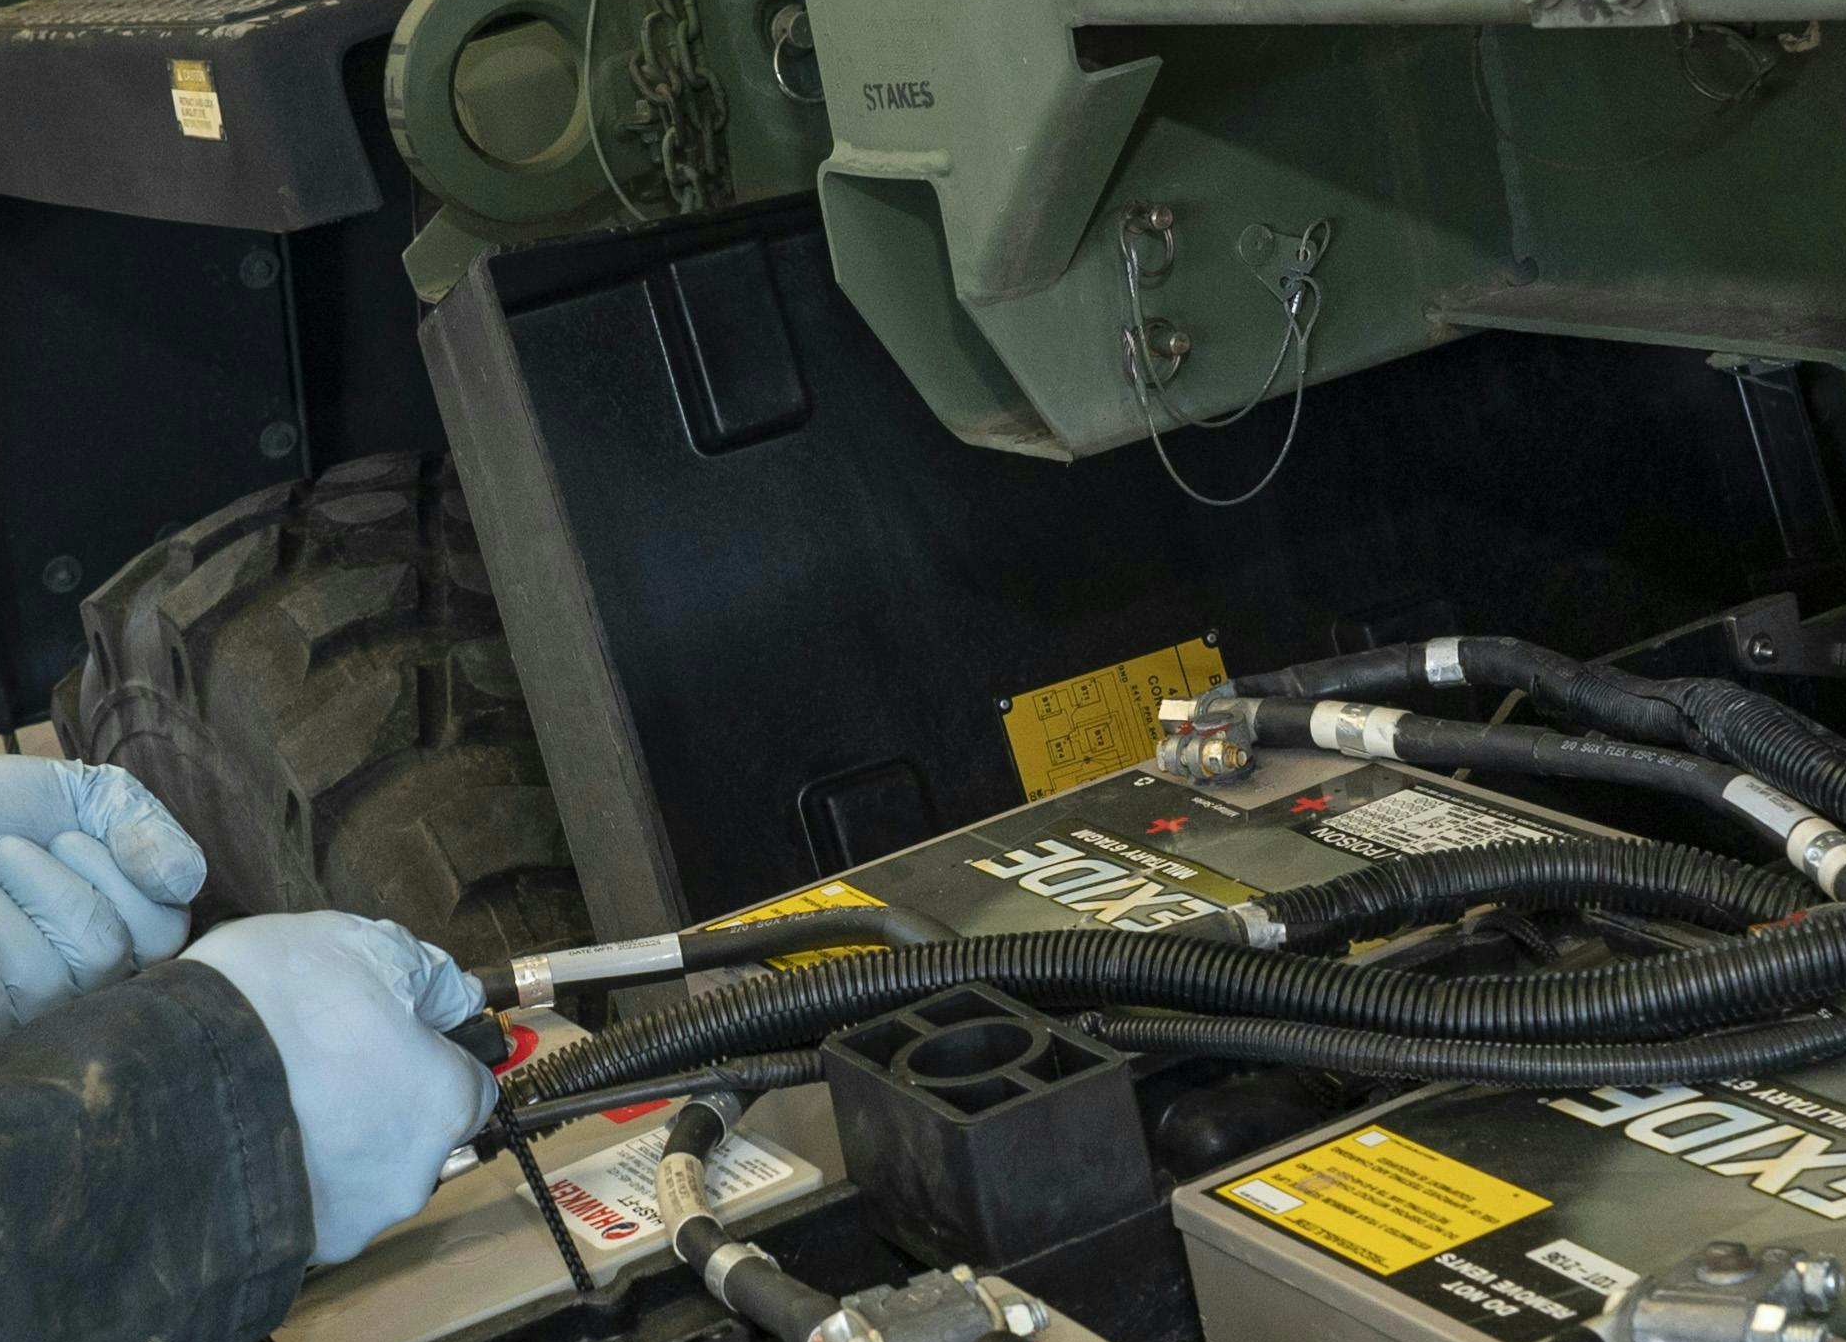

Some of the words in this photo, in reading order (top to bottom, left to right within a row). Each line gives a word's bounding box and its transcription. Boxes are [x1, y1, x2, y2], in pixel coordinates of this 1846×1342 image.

[863, 80, 935, 111] STAKES
[1117, 664, 1128, 684] GND
[1079, 683, 1091, 701] BT1
[1053, 740, 1066, 760] BT4
[1561, 739, 1578, 752] 2/0
[1580, 742, 1601, 754] SGX
[1604, 745, 1627, 758] FLEX
[1068, 827, 1130, 852] 6TAGM
[1308, 827, 1385, 856] POISON
[1117, 848, 1200, 880] MILITARY
[968, 838, 1227, 934] EXIDE
[1430, 1250, 1500, 1285] VENTS
[1437, 1279, 1492, 1302] NOT
[1486, 1278, 1580, 1320] REMOVE
[1478, 1295, 1522, 1318] DO
